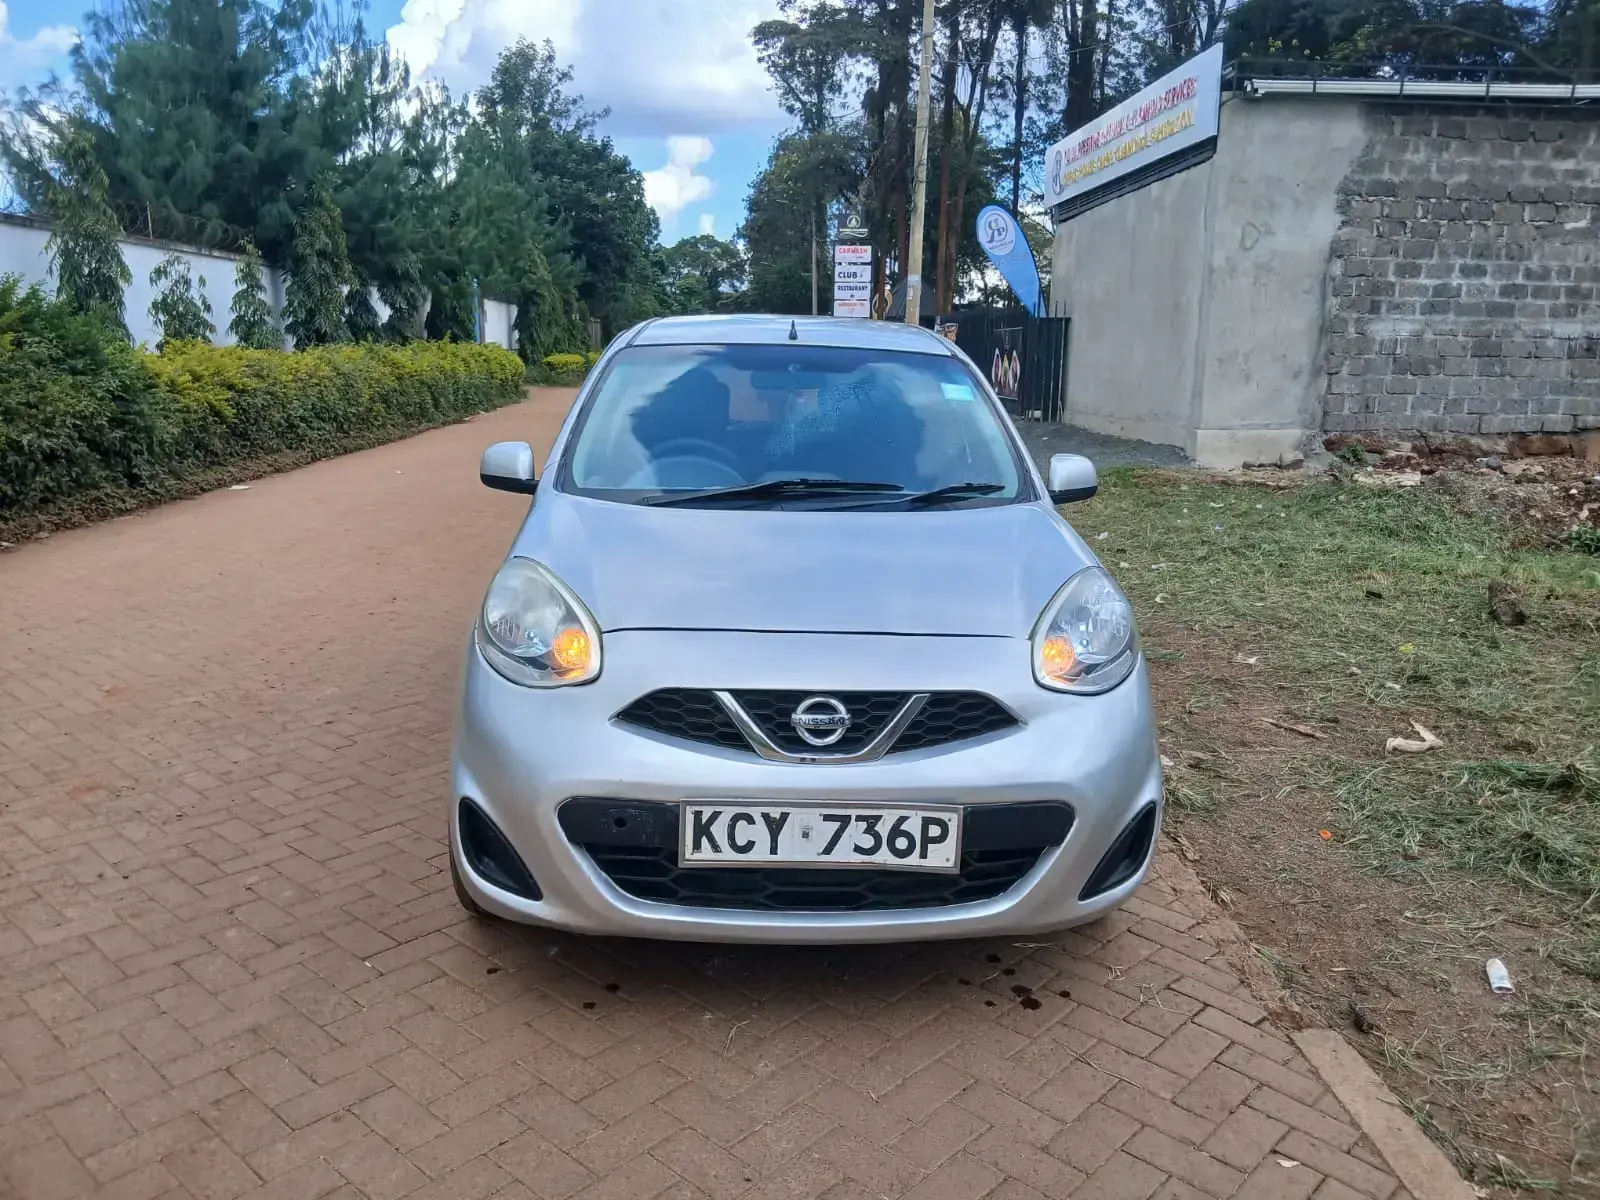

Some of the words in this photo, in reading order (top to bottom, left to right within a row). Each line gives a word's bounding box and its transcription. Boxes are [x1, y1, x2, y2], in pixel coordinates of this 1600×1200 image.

[837, 271, 858, 279] CLUB
[798, 716, 845, 726] NISSAN
[692, 810, 791, 856] KCY
[819, 813, 950, 860] 736P
